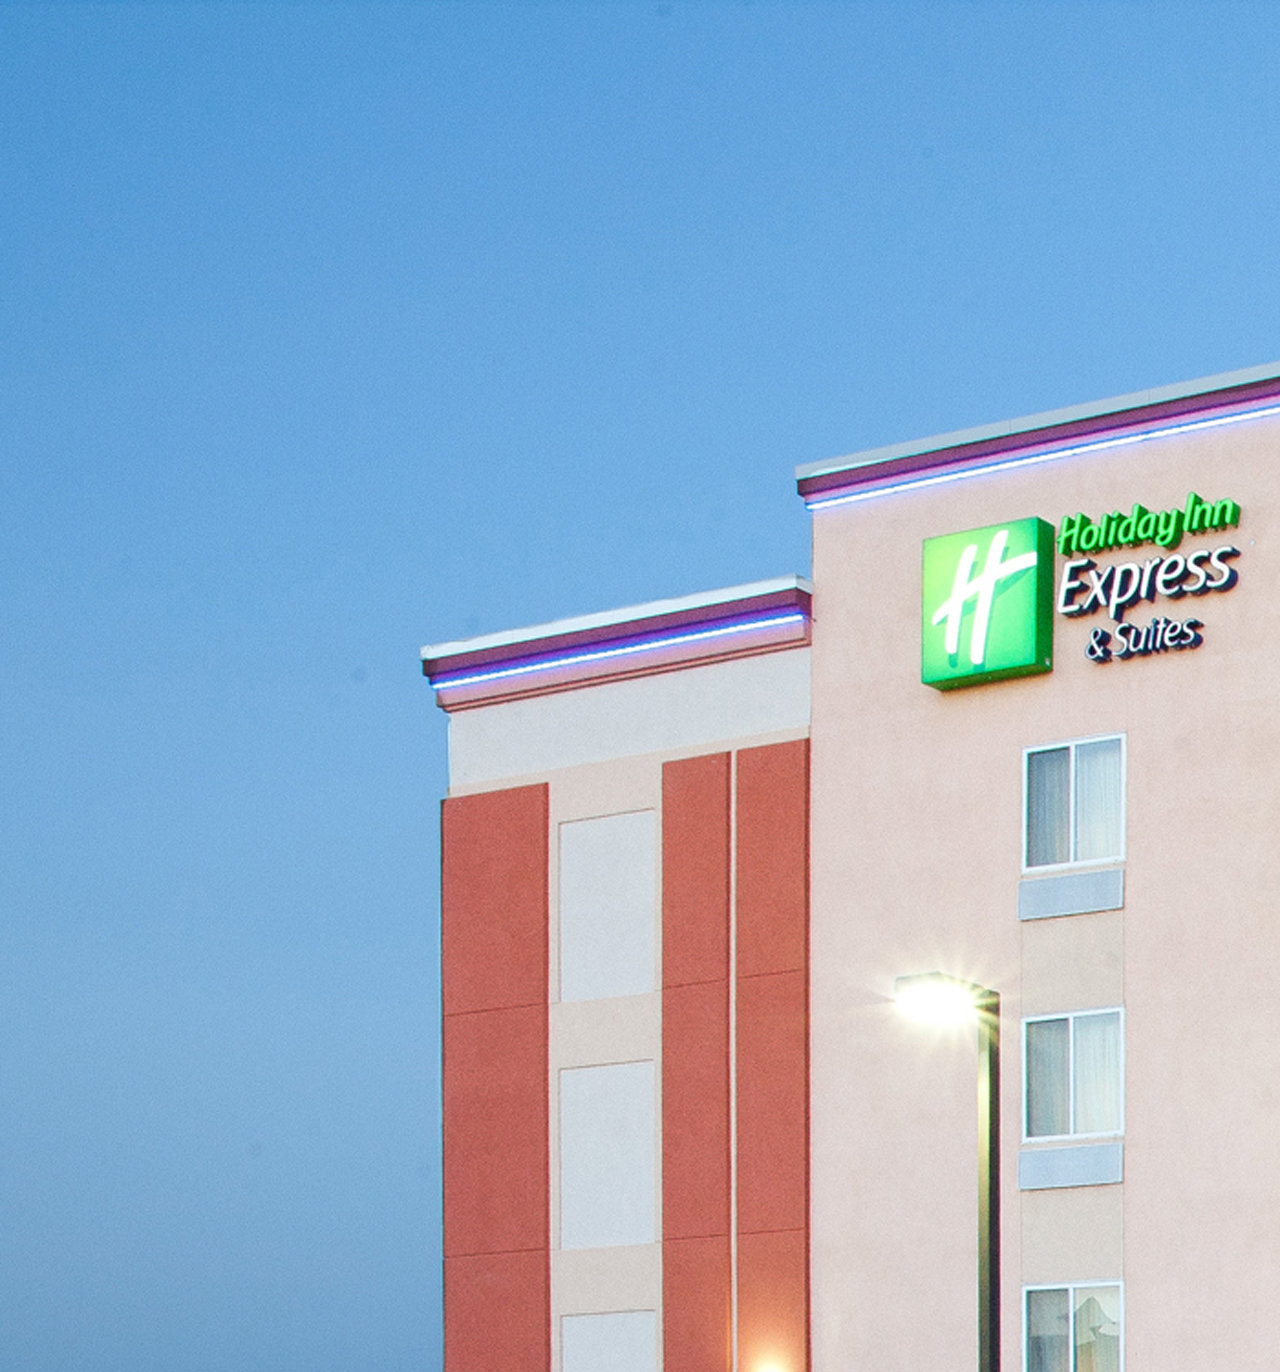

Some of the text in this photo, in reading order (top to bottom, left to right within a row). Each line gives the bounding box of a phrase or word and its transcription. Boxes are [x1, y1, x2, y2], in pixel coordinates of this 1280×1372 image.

[1057, 491, 1239, 551] Holiday Inn
[1057, 546, 1239, 621] Express
[1085, 617, 1203, 661] & Suites
